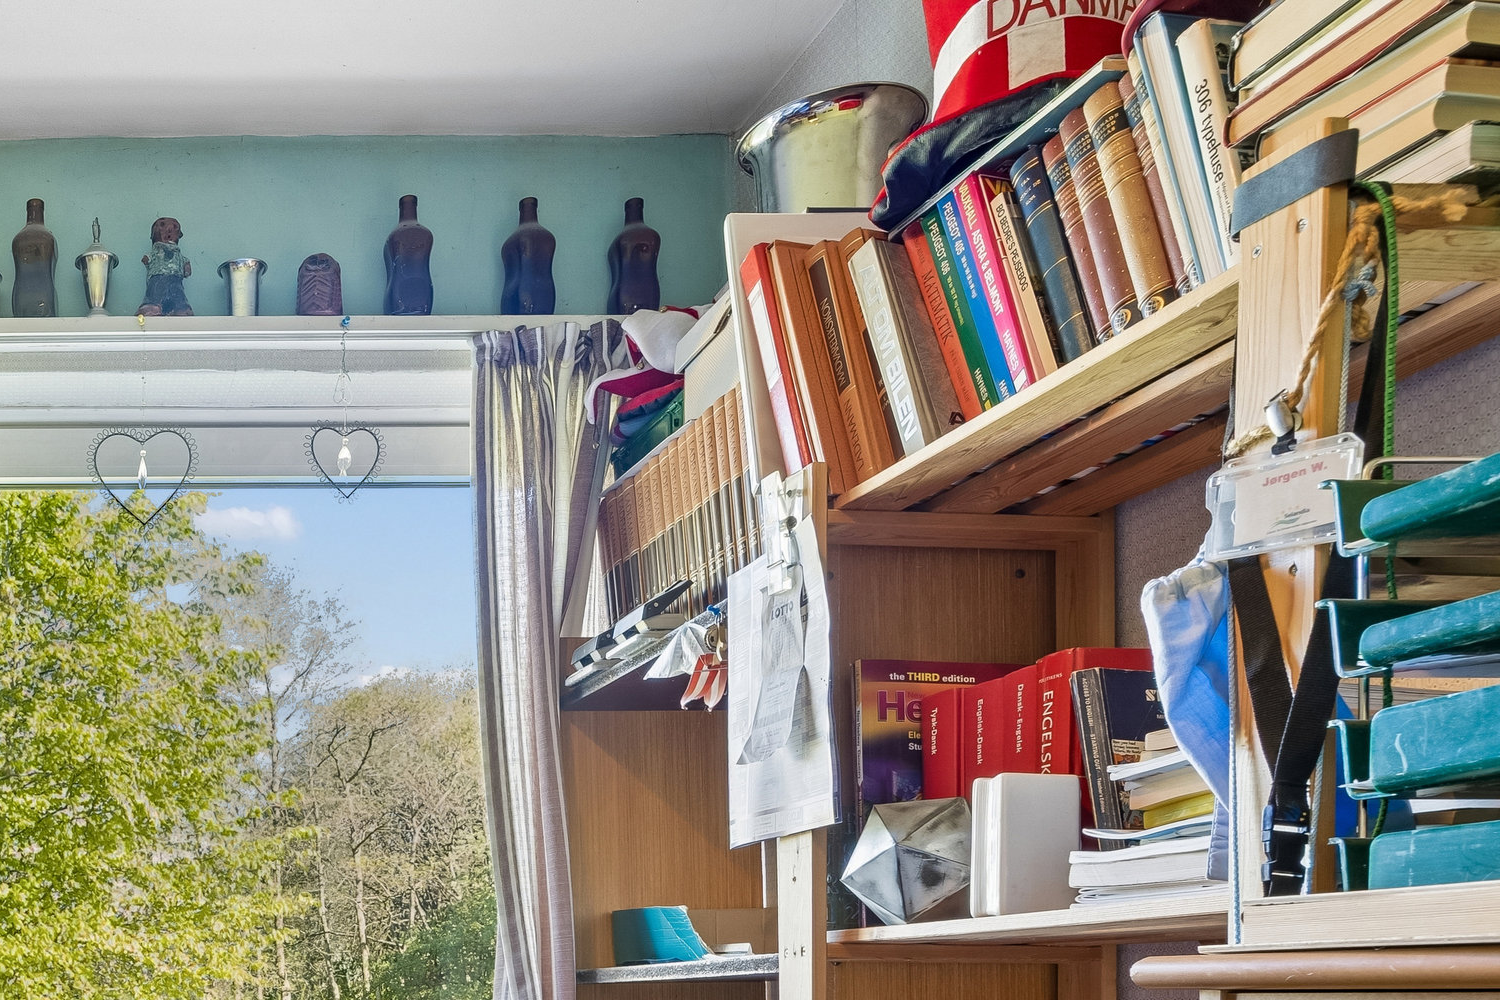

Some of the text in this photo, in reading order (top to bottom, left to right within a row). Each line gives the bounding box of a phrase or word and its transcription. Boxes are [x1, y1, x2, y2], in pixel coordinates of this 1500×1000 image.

[1194, 78, 1224, 184] 306 typehuse
[942, 201, 960, 240] PEUGEOT
[954, 240, 966, 256] 405
[996, 204, 1029, 292] BO BEDRE'S PEJSEBOG
[921, 269, 954, 346] MATEMATIK
[929, 223, 947, 262] PEUGEOT
[973, 367, 989, 401] HAYNES
[959, 180, 1020, 371] VAUXHALL ASTRA & BELMONT HAYNES
[819, 297, 847, 388] MADVARELEKSIKON
[859, 264, 918, 442] ALT OM BILEN
[843, 398, 865, 472] LADEMANN
[1262, 461, 1328, 488] Jørgen W.
[770, 600, 794, 621] LOTTO
[889, 672, 976, 683] the THIRD edition
[1017, 683, 1025, 712] Dansk
[1038, 672, 1063, 684] POLITIKENS
[930, 707, 938, 755] Tysk-Dansk
[1041, 690, 1054, 775] ENGELSK
